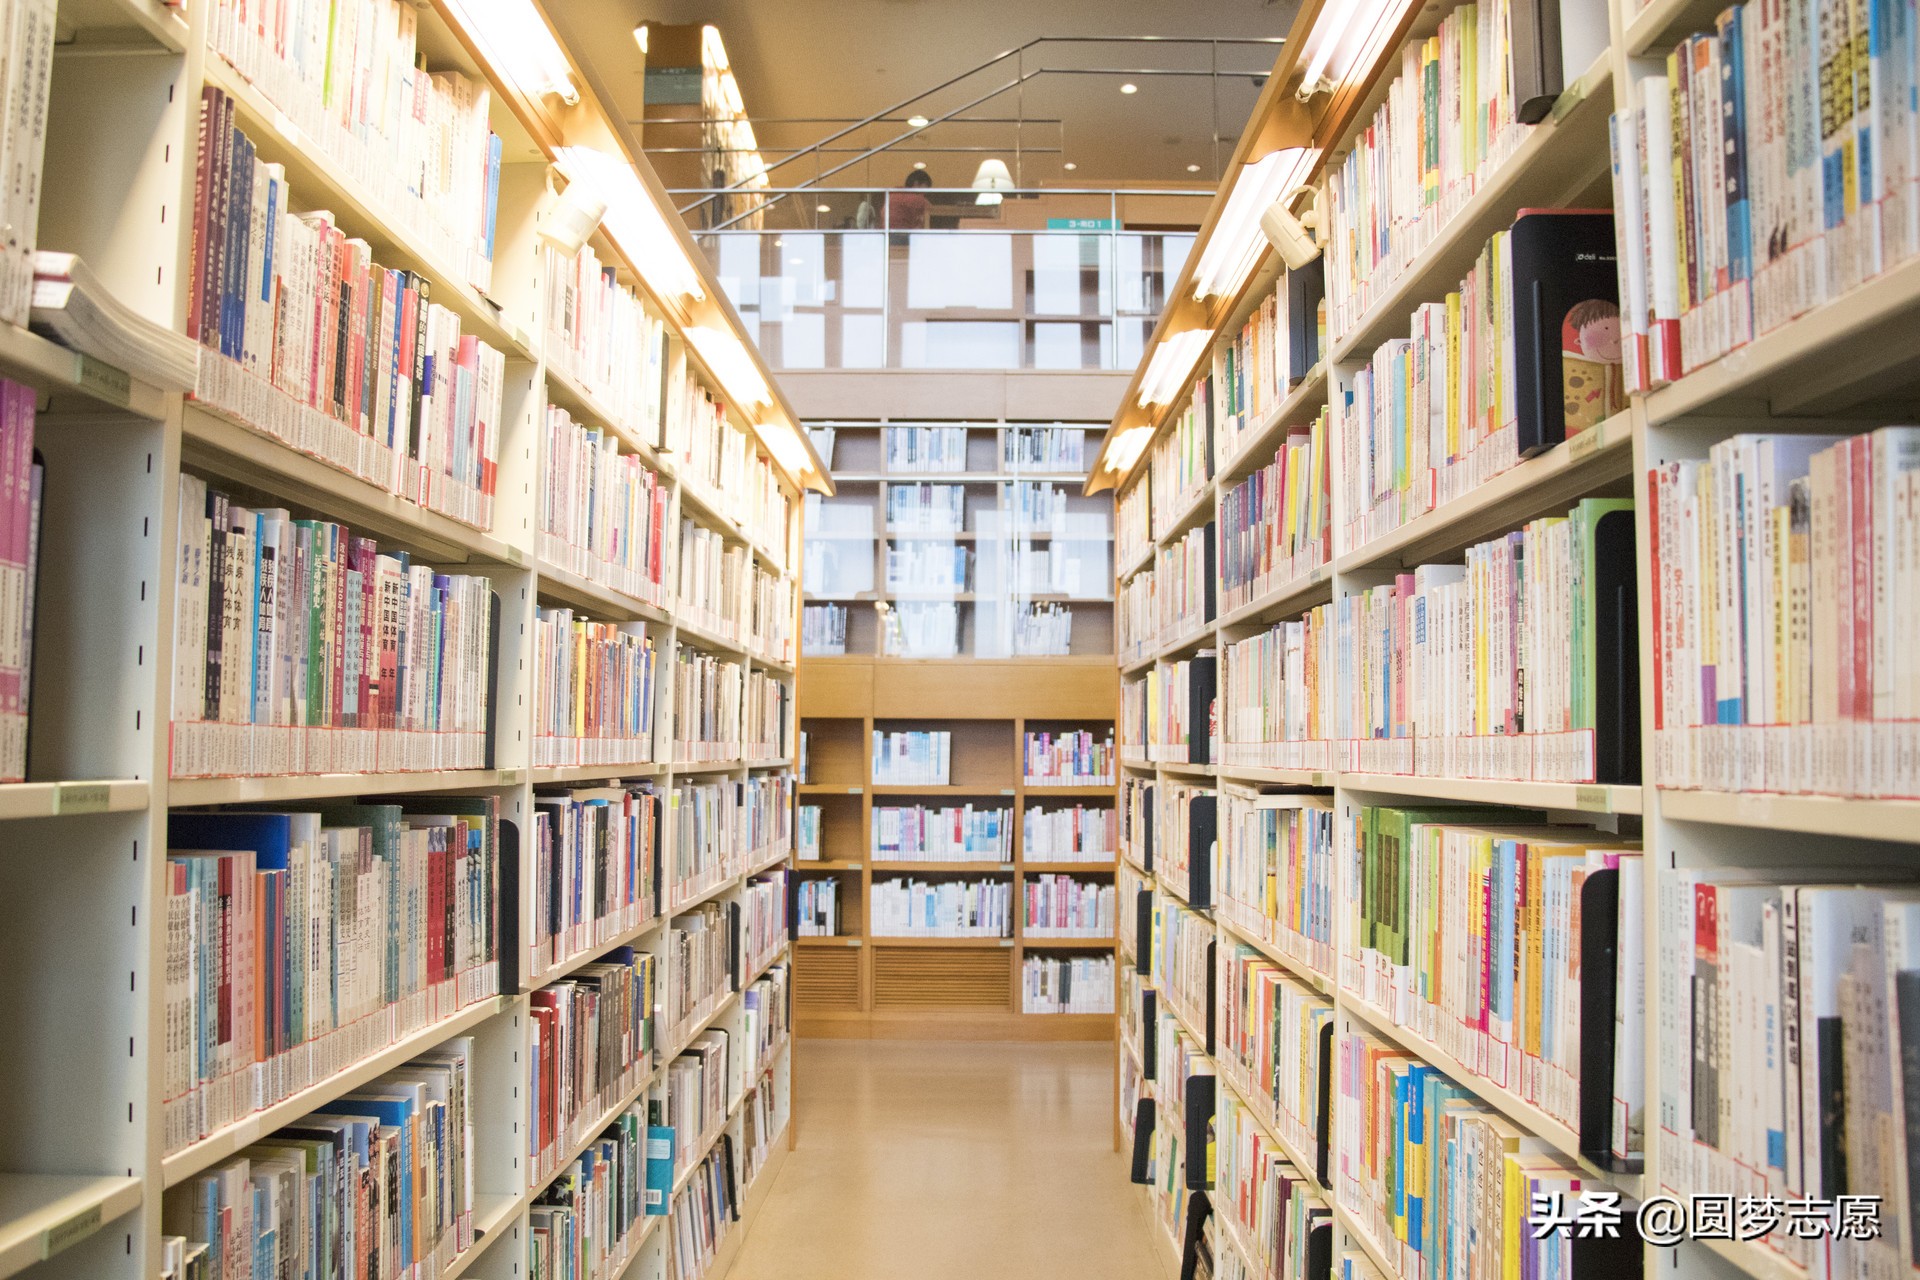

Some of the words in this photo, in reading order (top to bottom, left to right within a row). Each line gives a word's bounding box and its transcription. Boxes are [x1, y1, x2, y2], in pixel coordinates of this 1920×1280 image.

[223, 545, 235, 630] 残疾人体育
[233, 548, 246, 631] 残疾人体育
